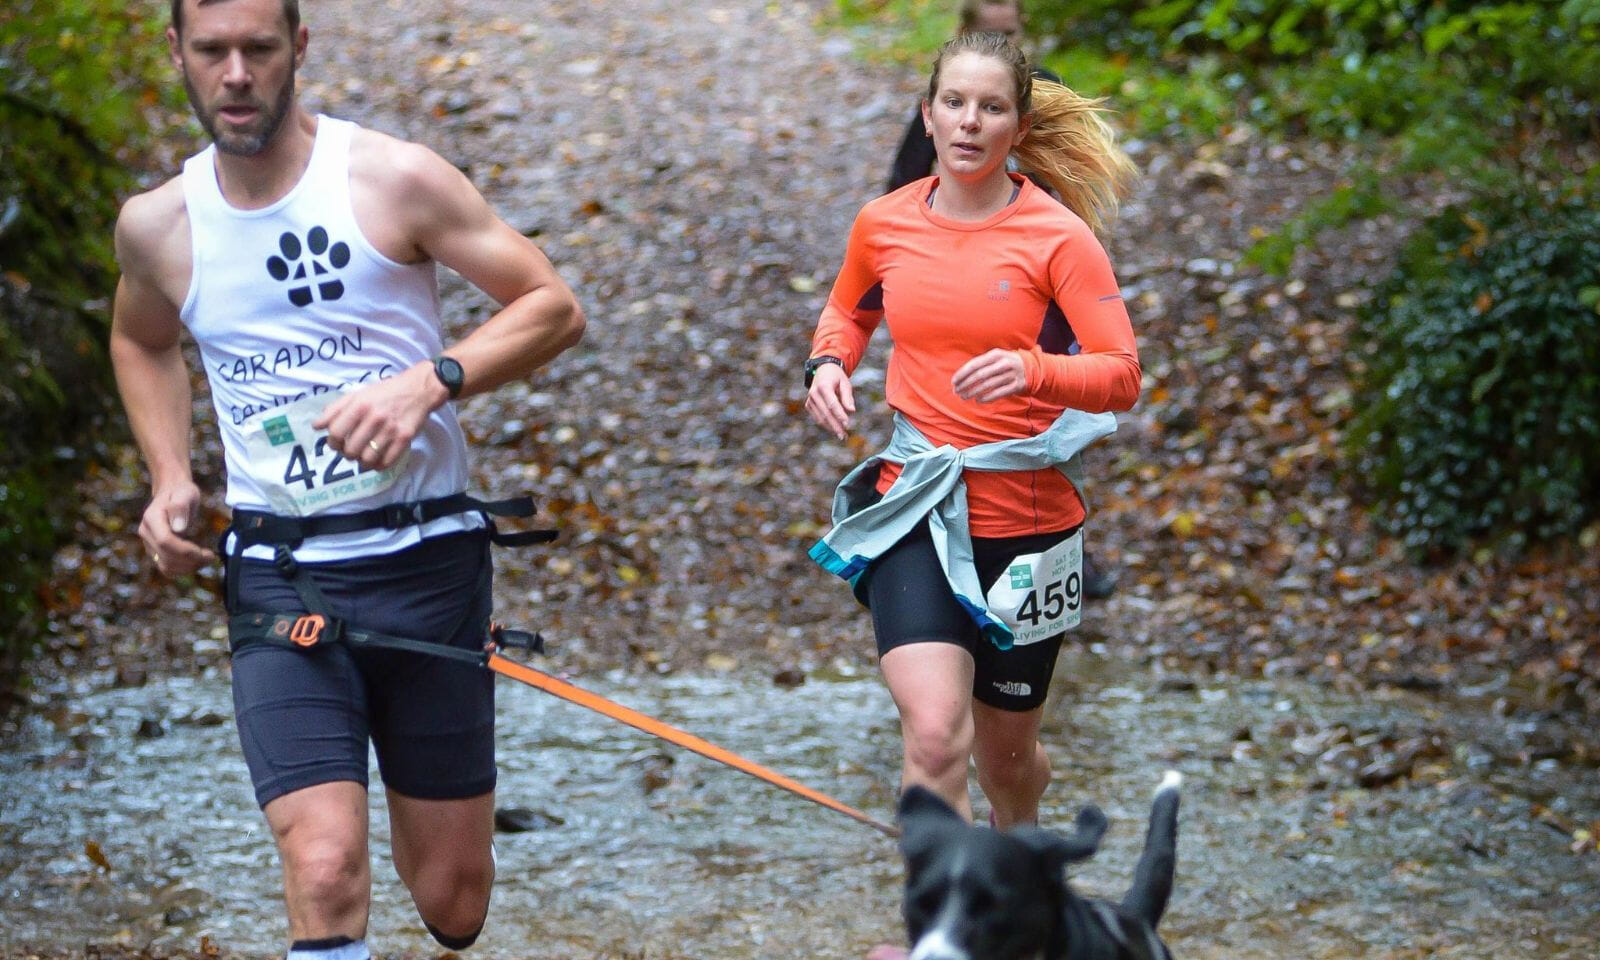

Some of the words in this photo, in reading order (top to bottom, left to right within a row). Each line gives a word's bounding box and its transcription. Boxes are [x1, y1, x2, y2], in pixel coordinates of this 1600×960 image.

[217, 326, 363, 383] CARADON
[284, 435, 376, 490] 42
[1016, 571, 1081, 627] 459
[1014, 627, 1046, 640] LIVING
[1048, 621, 1065, 631] FOR
